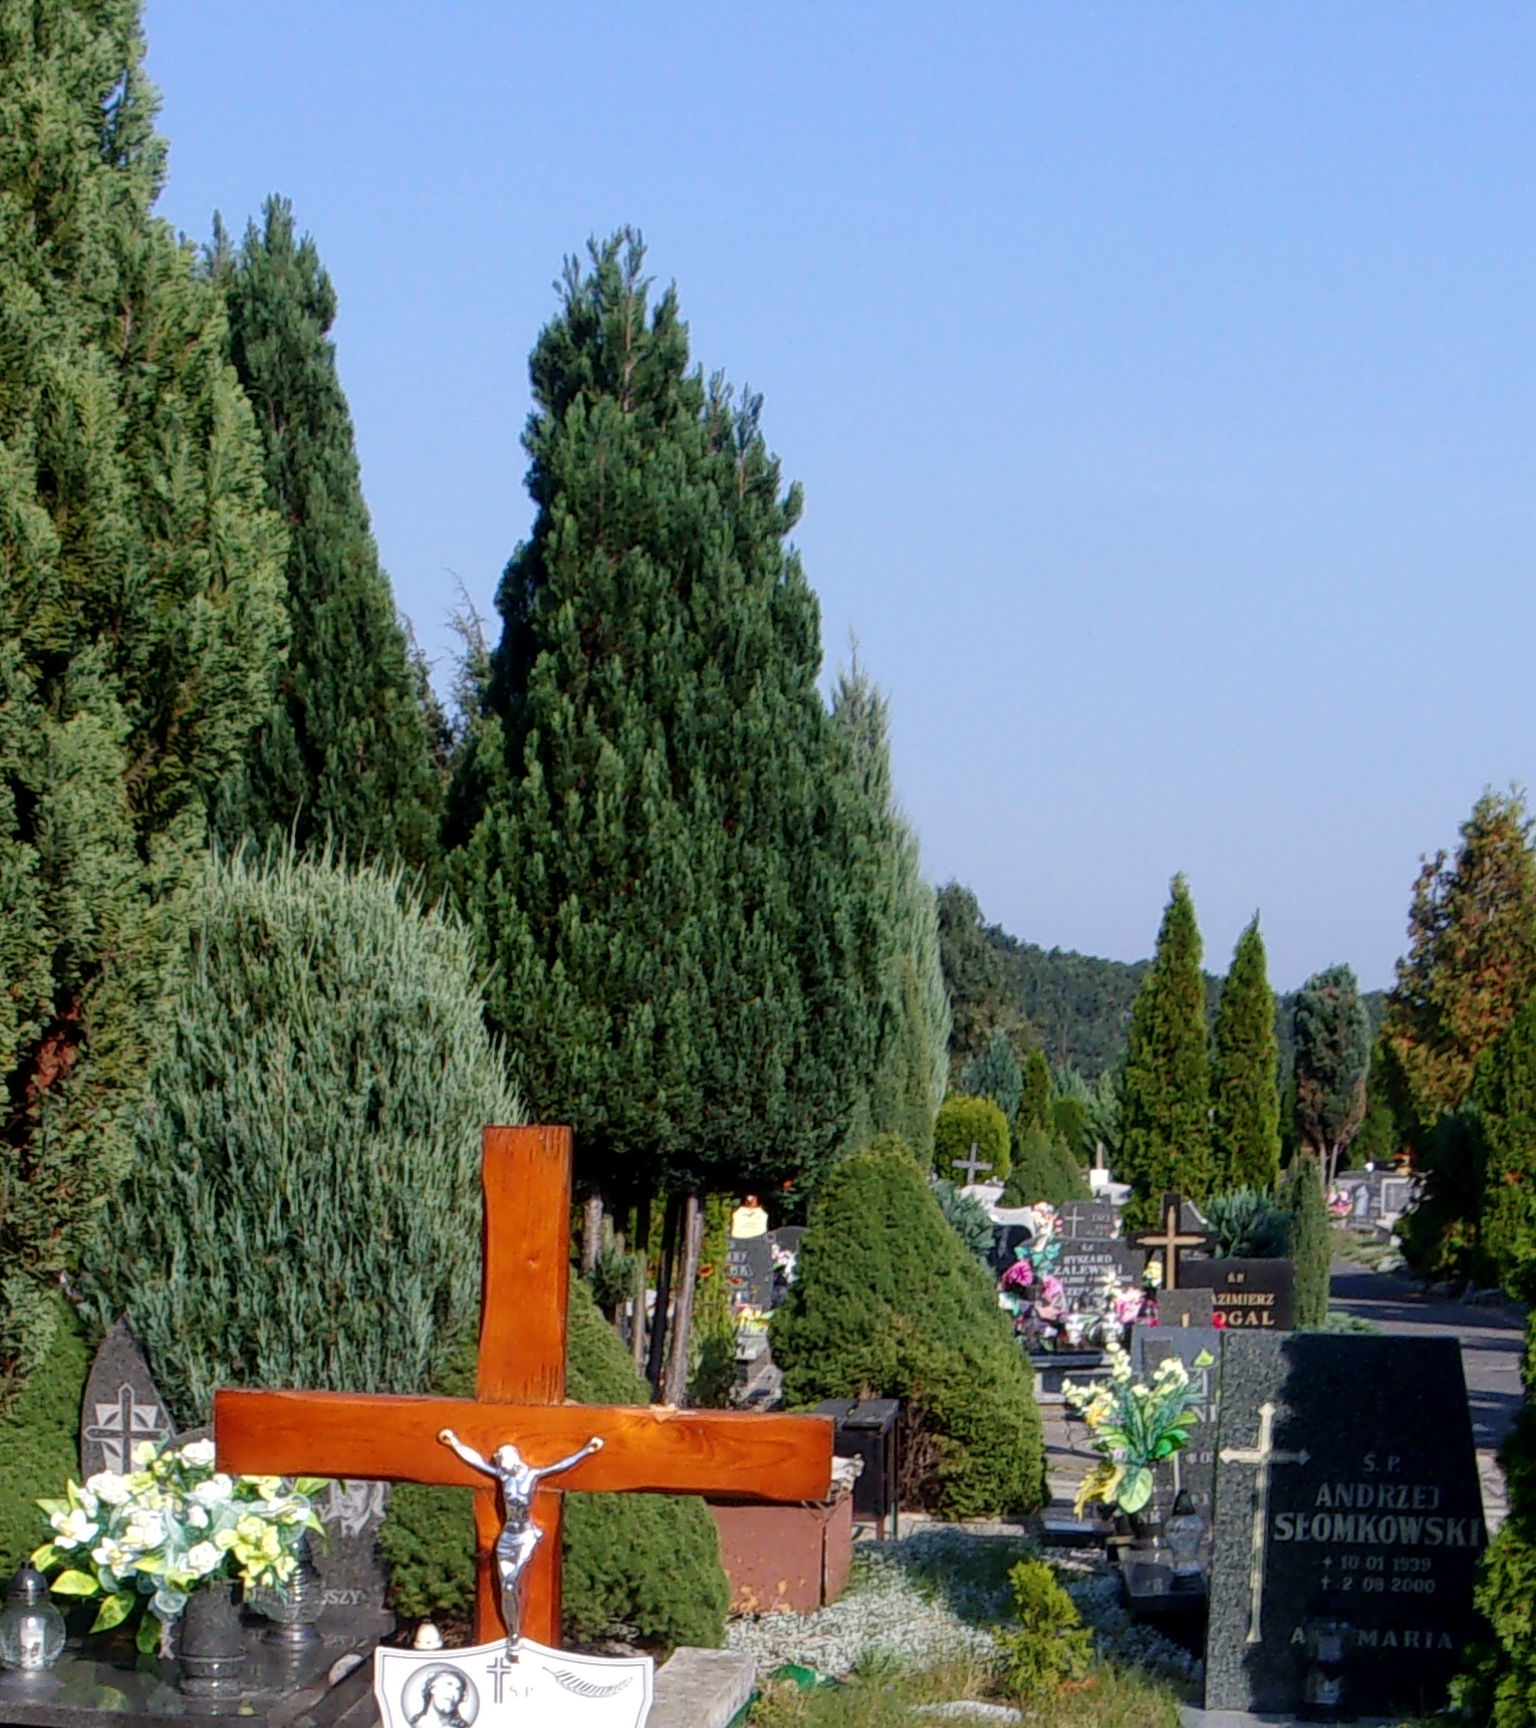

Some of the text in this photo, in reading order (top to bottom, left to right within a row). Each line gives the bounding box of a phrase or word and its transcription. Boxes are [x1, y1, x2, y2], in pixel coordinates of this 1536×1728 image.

[1211, 1293, 1276, 1307] AZIMIERZ
[1217, 1310, 1276, 1327] OGAL
[1315, 1482, 1441, 1510] ANDRZEJ
[1272, 1511, 1483, 1548] SŁOMKOWSKI
[1390, 1578, 1437, 1594] 2000
[1357, 1628, 1454, 1650] MARIA
